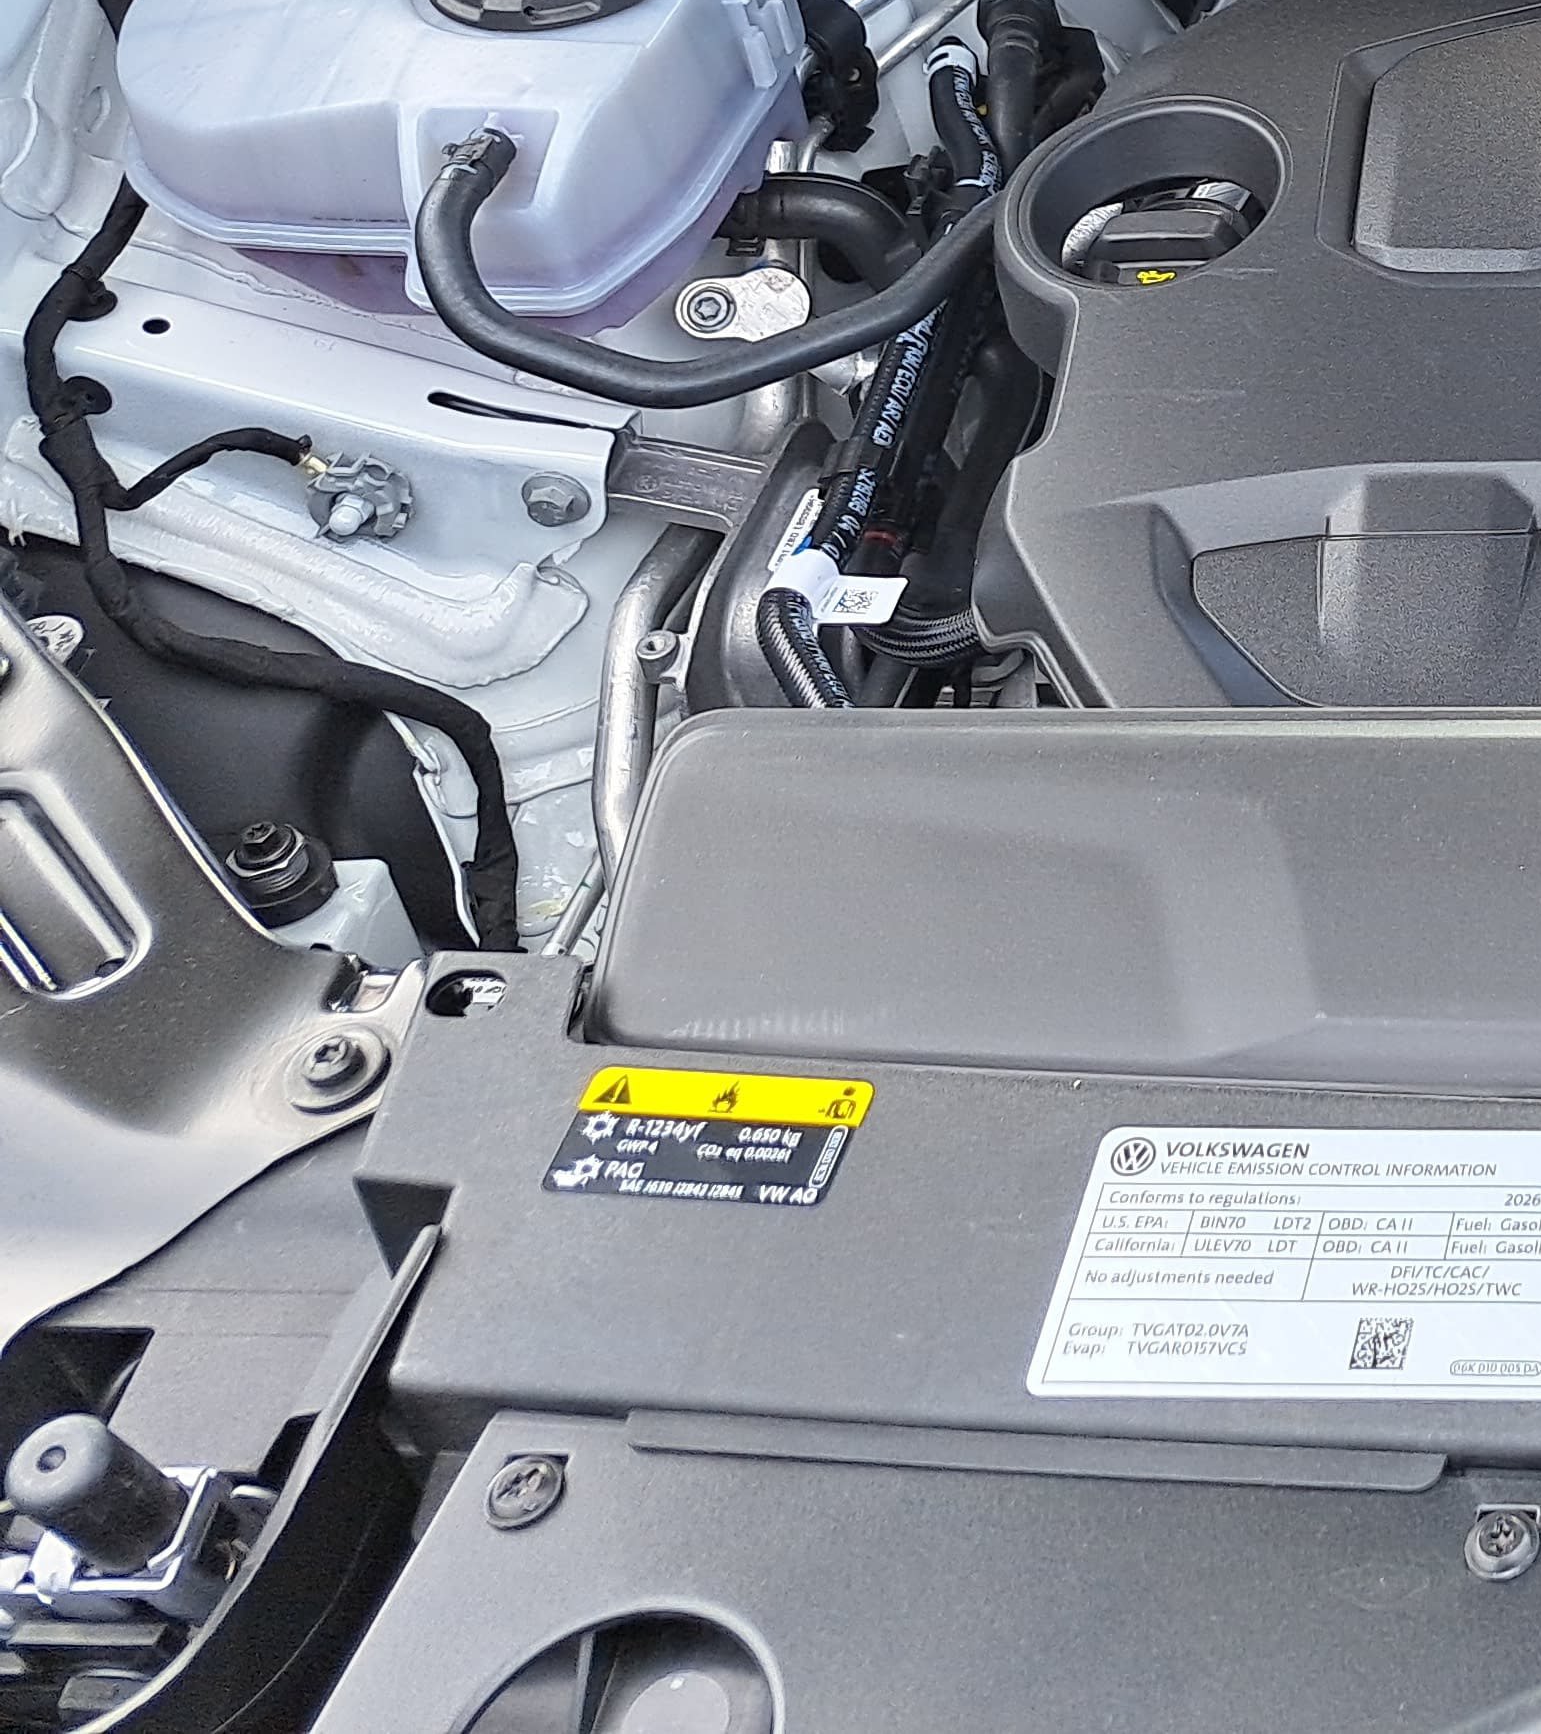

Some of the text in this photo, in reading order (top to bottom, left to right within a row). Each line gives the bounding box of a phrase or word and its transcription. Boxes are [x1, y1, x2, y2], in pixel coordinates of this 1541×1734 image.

[626, 1119, 708, 1144] R-1234yf
[738, 1127, 802, 1148] 0.650 kg
[1166, 1142, 1310, 1158] VOLKSWAGEN
[1160, 1161, 1496, 1177] VEHICLE EMISSION CONTROL INFORMATION
[759, 1185, 818, 1204] VW AG
[1109, 1190, 1184, 1205] Conforms
[1189, 1192, 1204, 1204] to
[1504, 1193, 1541, 1207] 2026
[1102, 1216, 1168, 1229] U.S. EPA:
[1200, 1217, 1311, 1230] BIN70 LDT2
[1328, 1218, 1397, 1231] OBD: CA
[1456, 1218, 1492, 1232] Fuel:
[1094, 1239, 1175, 1252] California:
[1194, 1239, 1298, 1253] ULEV70 LDT
[1322, 1240, 1392, 1254] OBD: CA
[1451, 1241, 1487, 1254] Fuel:
[1085, 1270, 1274, 1286] No adjustments needed
[1391, 1265, 1490, 1279] DFI/TC/CAC/
[1352, 1282, 1522, 1296] WR-HO2S/HO2S/TWC
[1069, 1323, 1123, 1339] Group:
[1063, 1342, 1105, 1358] Evap:
